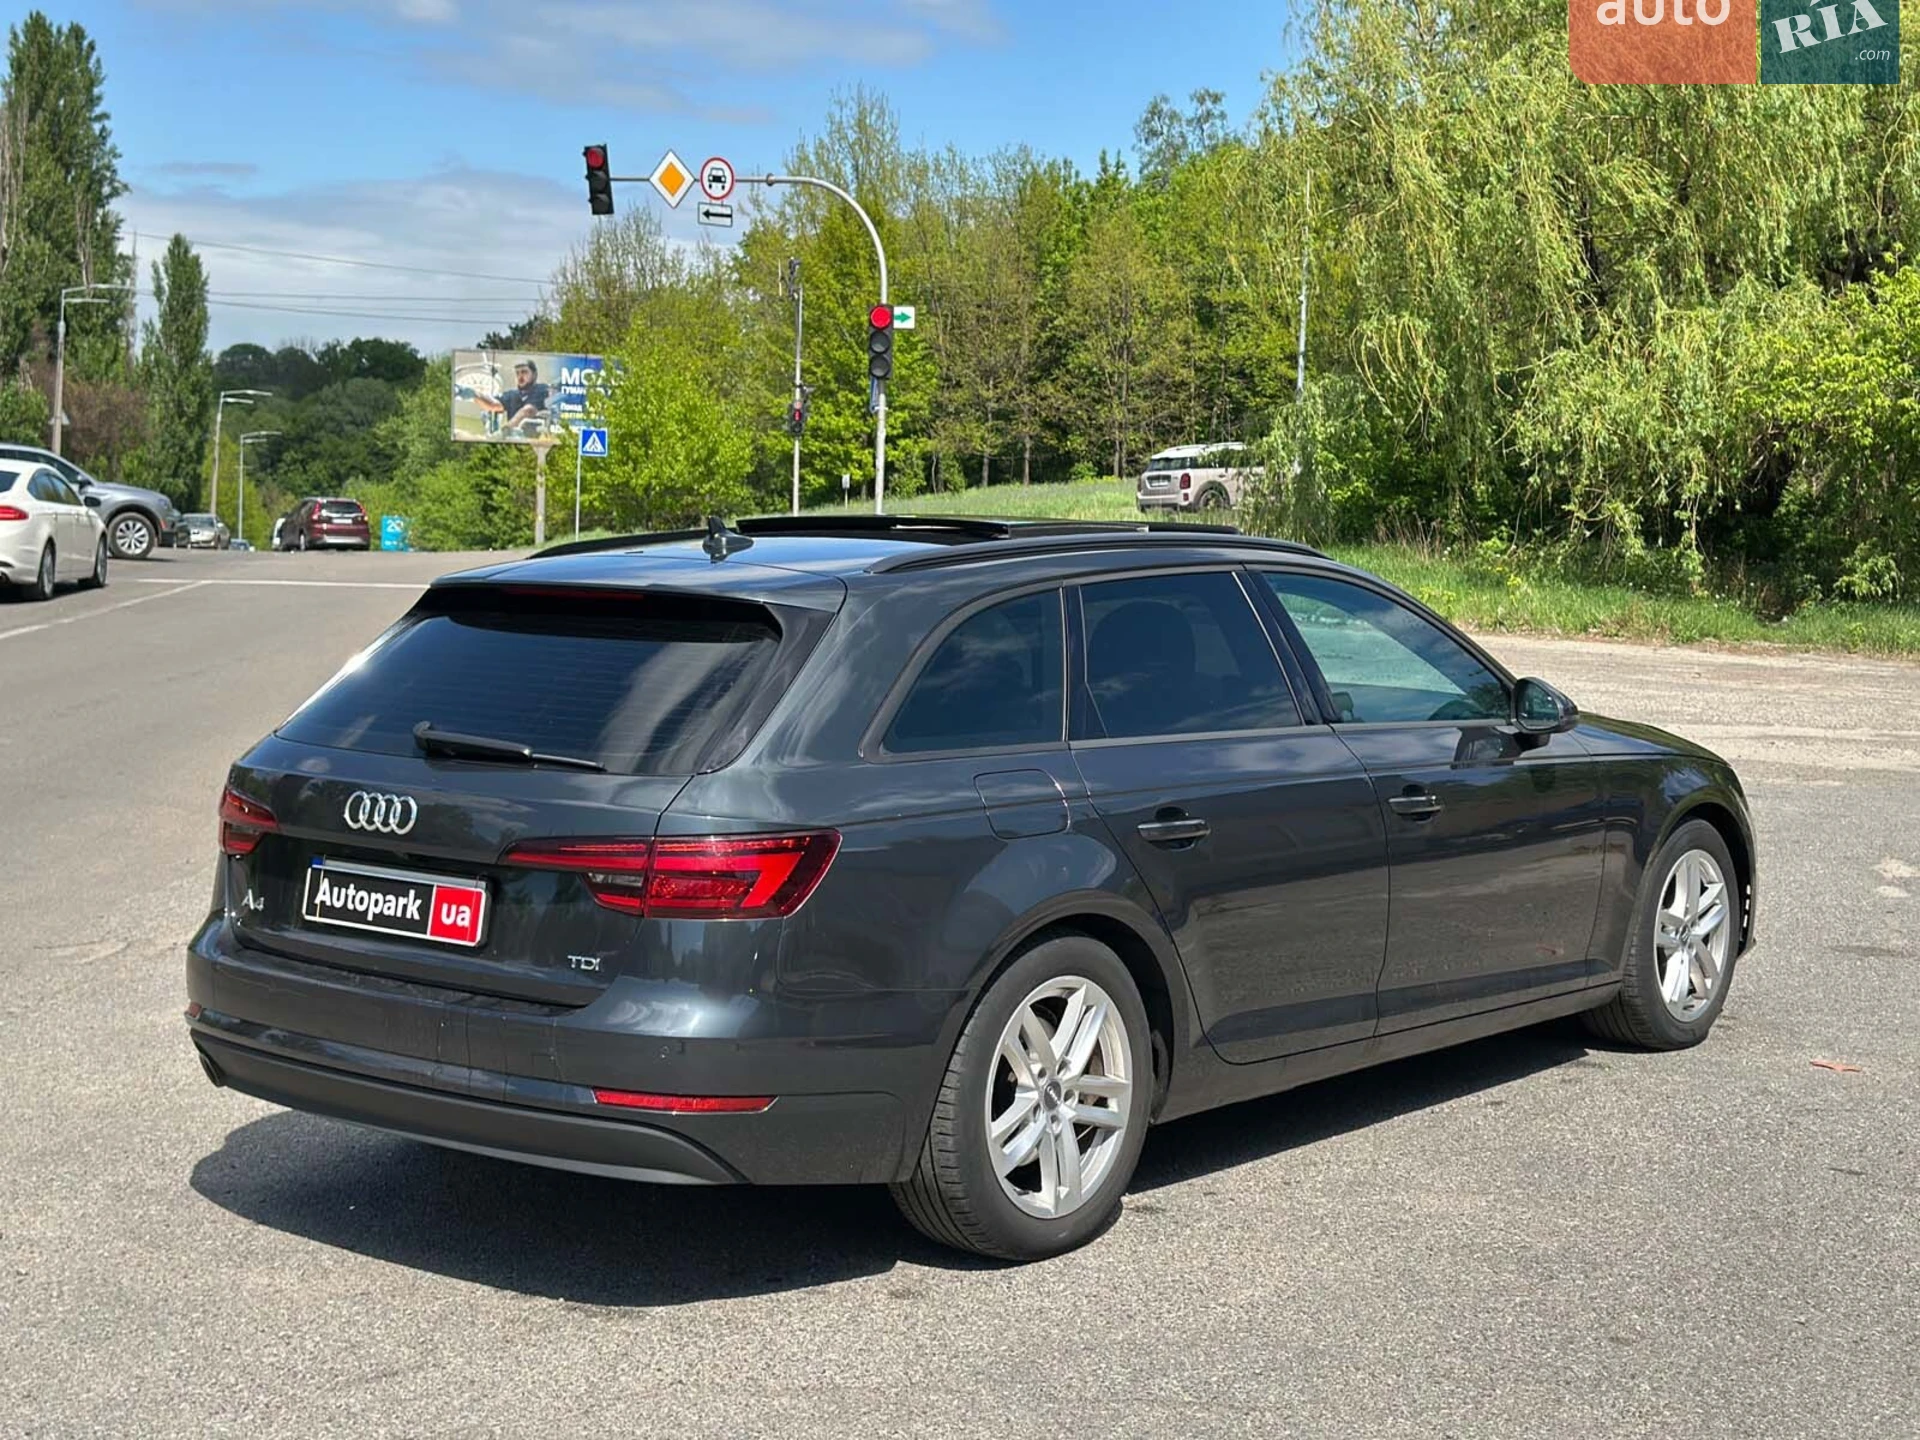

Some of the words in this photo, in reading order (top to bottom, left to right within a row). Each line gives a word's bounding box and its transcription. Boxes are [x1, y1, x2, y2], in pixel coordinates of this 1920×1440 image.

[241, 888, 265, 912] A4
[314, 877, 422, 921] Autopark
[440, 902, 472, 928] ua
[567, 955, 601, 971] TDI
